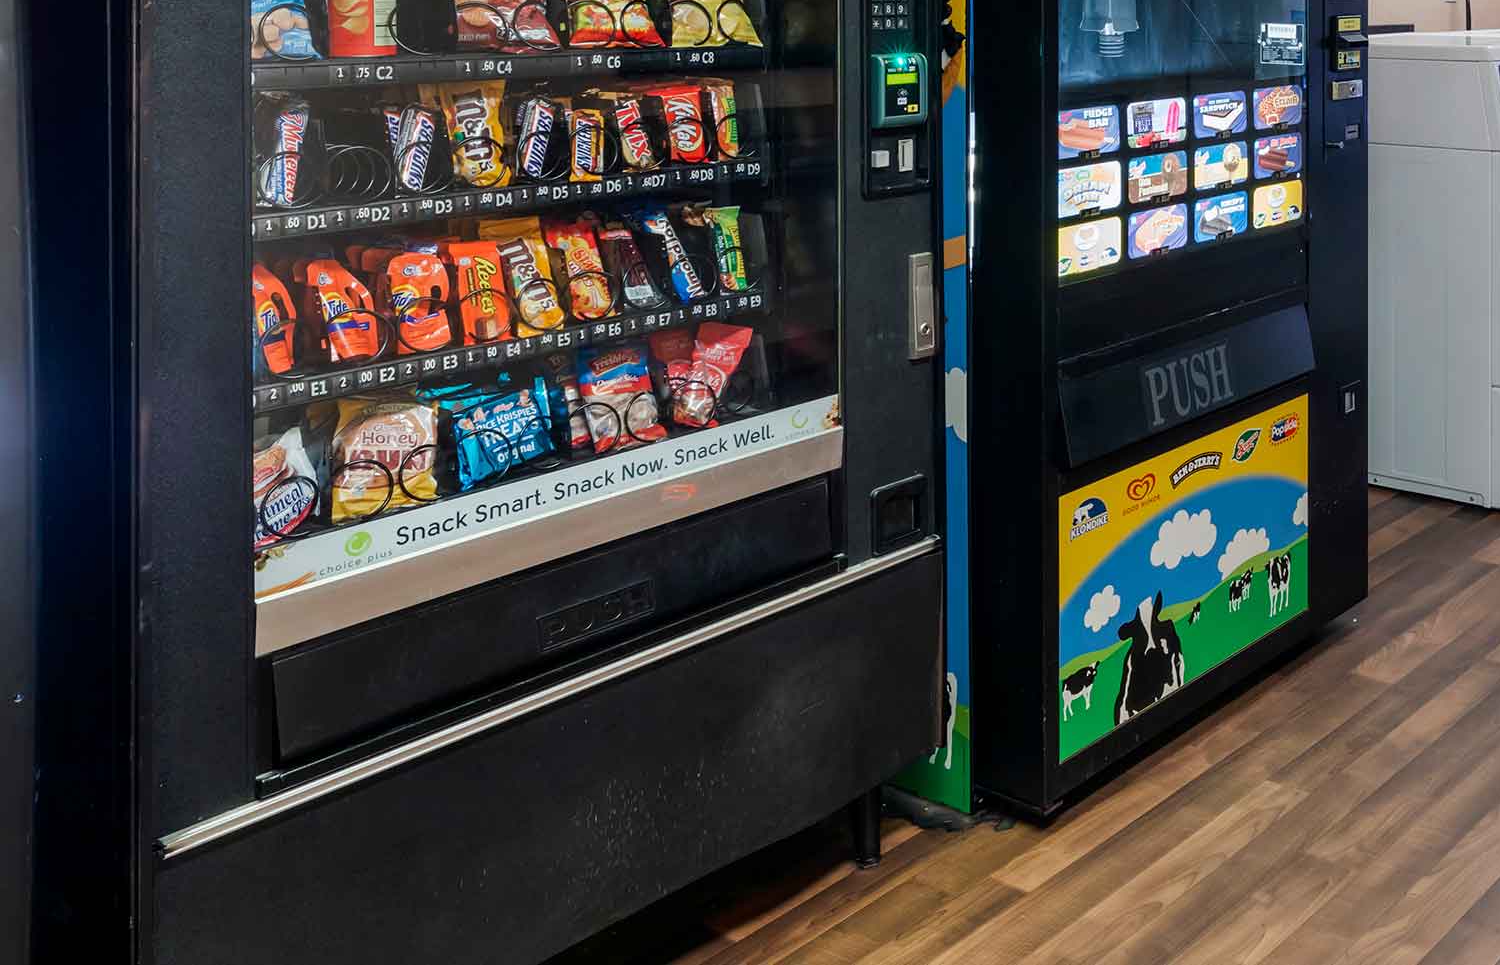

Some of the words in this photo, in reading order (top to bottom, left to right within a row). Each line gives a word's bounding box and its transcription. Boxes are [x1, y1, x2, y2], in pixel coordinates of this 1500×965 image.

[607, 55, 621, 69] C6
[702, 51, 715, 65] C8
[376, 66, 393, 80] C2
[497, 61, 513, 74] C4
[1083, 106, 1113, 119] FUDGE
[1200, 102, 1238, 113] SANDWICH
[1088, 118, 1109, 129] BAR
[615, 100, 651, 162] TWIX
[700, 168, 714, 181] D8
[747, 163, 761, 176] D9
[606, 179, 622, 193] D6
[651, 174, 666, 187] D7
[496, 192, 513, 206] D4
[553, 185, 569, 200] D5
[434, 199, 453, 214] D3
[371, 206, 391, 223] D2
[307, 214, 328, 230] D1
[750, 296, 762, 308] E9
[327, 300, 350, 320] Tide
[705, 304, 718, 317] E8
[659, 313, 672, 326] E7
[608, 323, 622, 337] E6
[557, 333, 571, 347] E5
[506, 343, 521, 357] E4
[443, 355, 459, 370] E3
[379, 367, 396, 383] E2
[311, 381, 328, 397] E1
[1144, 344, 1234, 427] PUSH
[475, 419, 498, 432] RICE
[496, 405, 537, 425] KRISPIES
[362, 431, 418, 447] Honey
[395, 511, 468, 546] Snack
[475, 490, 547, 524] Smart.
[554, 469, 616, 502] Snack
[621, 456, 669, 484] Now.
[673, 438, 729, 466] Snack
[733, 426, 776, 451] Well.
[1070, 513, 1109, 541] KLONDIKE
[319, 557, 362, 577] choice
[366, 548, 394, 568] plus
